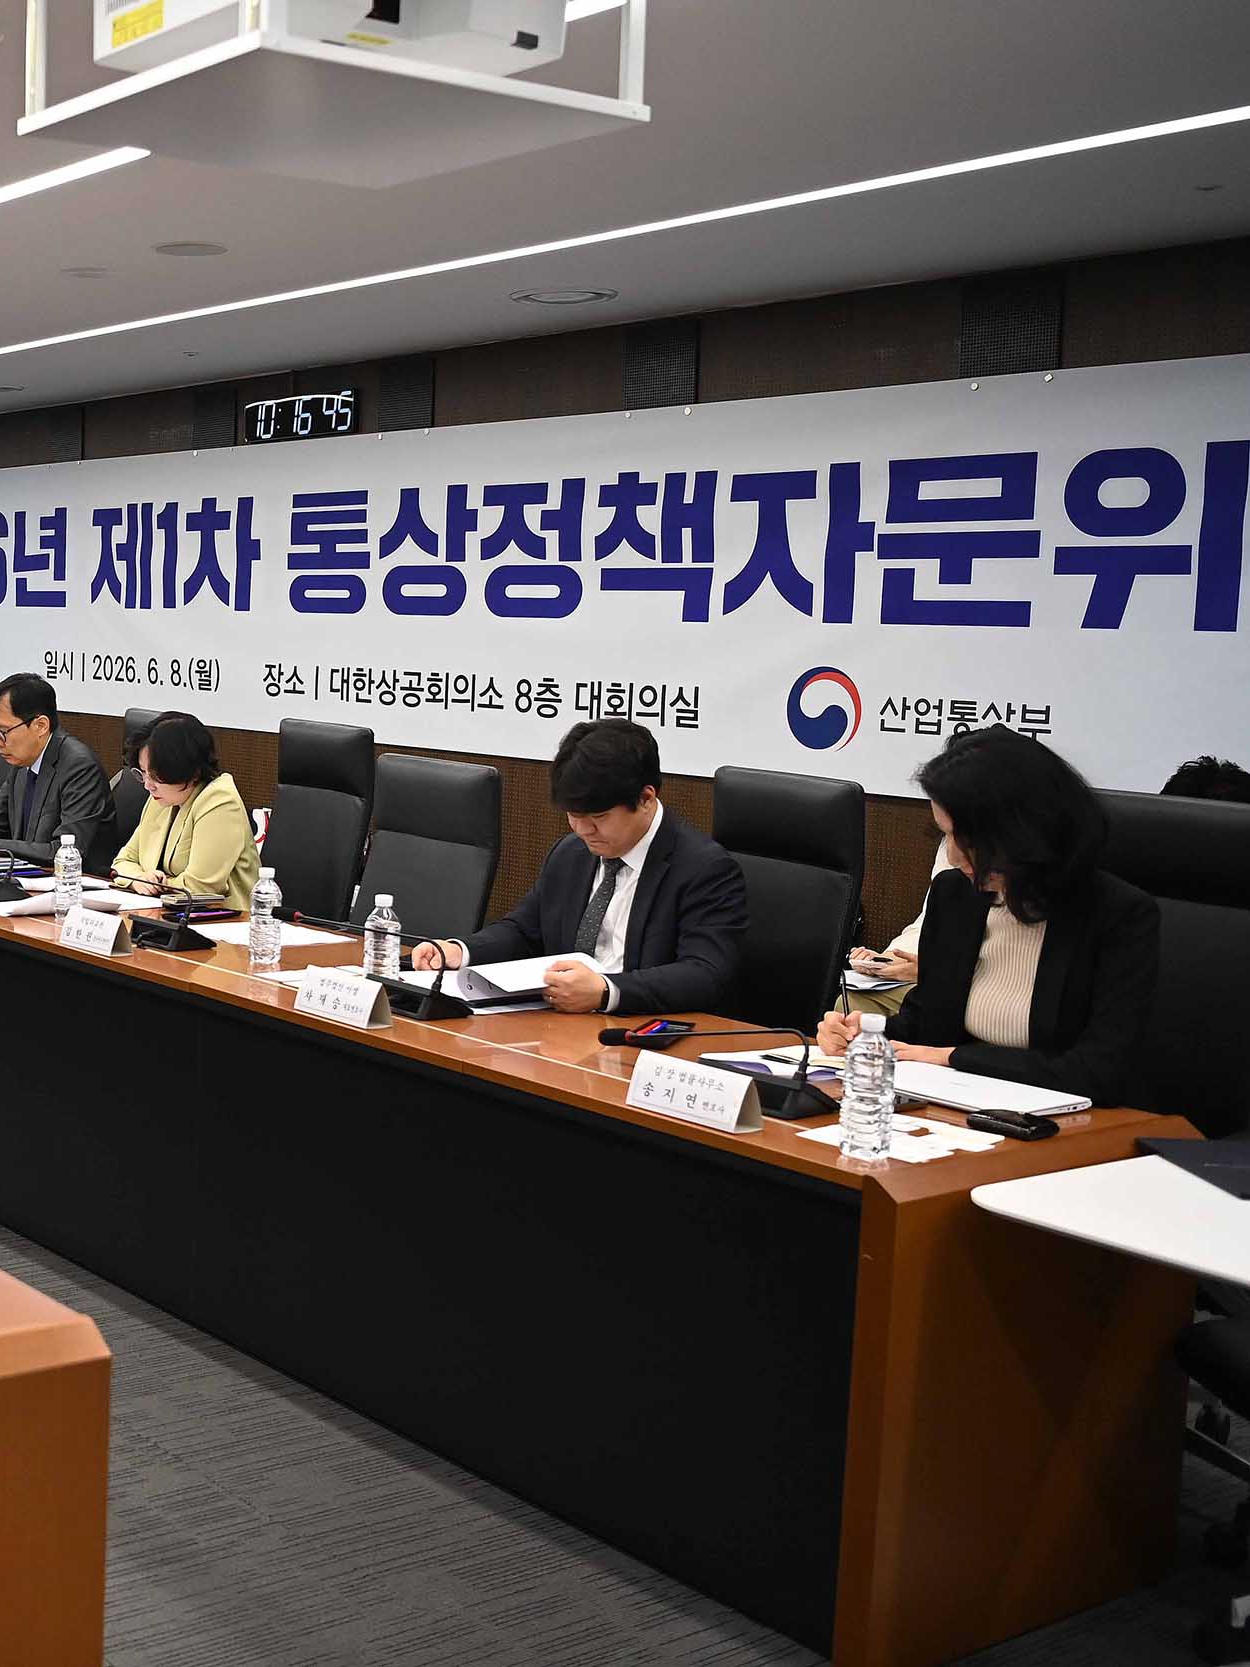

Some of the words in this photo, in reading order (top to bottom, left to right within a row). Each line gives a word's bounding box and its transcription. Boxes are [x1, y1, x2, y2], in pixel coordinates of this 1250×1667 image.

[323, 390, 352, 430] 45
[91, 496, 261, 611] 제1차
[287, 439, 1250, 632] 통상정책자문위
[44, 650, 74, 681] 일시
[92, 654, 141, 684] 2026.
[147, 657, 164, 686] 6.
[262, 662, 306, 698] 장소
[329, 666, 505, 713] 대한상공회의소
[514, 677, 563, 719] 8층
[575, 680, 700, 729] 대회의실
[879, 696, 1052, 741] 산업통상부
[678, 1071, 725, 1092] 법률사무소
